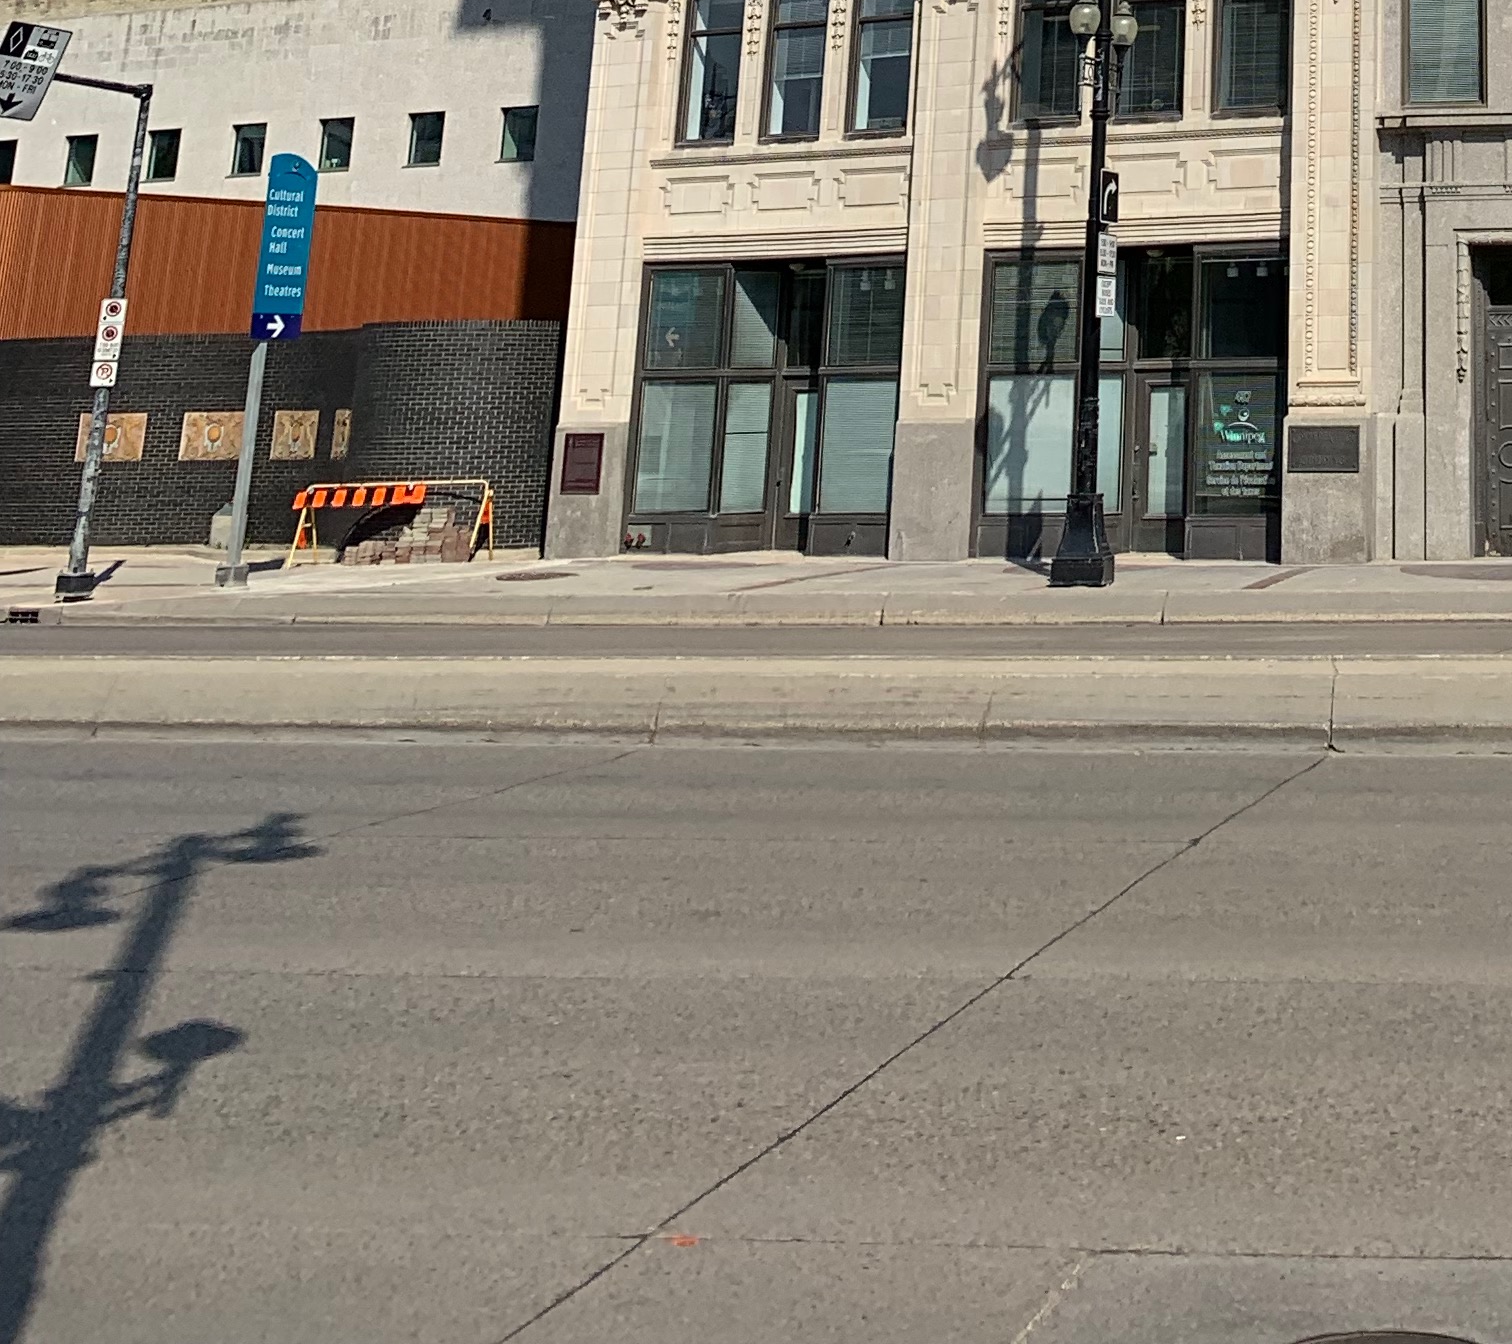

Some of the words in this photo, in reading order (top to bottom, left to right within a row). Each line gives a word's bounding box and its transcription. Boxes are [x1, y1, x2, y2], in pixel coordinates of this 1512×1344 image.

[269, 188, 304, 203] Cultural
[267, 204, 299, 218] District
[271, 225, 305, 240] Concert
[269, 241, 288, 255] Hall
[266, 263, 302, 276] Museum
[264, 284, 302, 299] Theatres
[1220, 429, 1266, 444] Winnipeg
